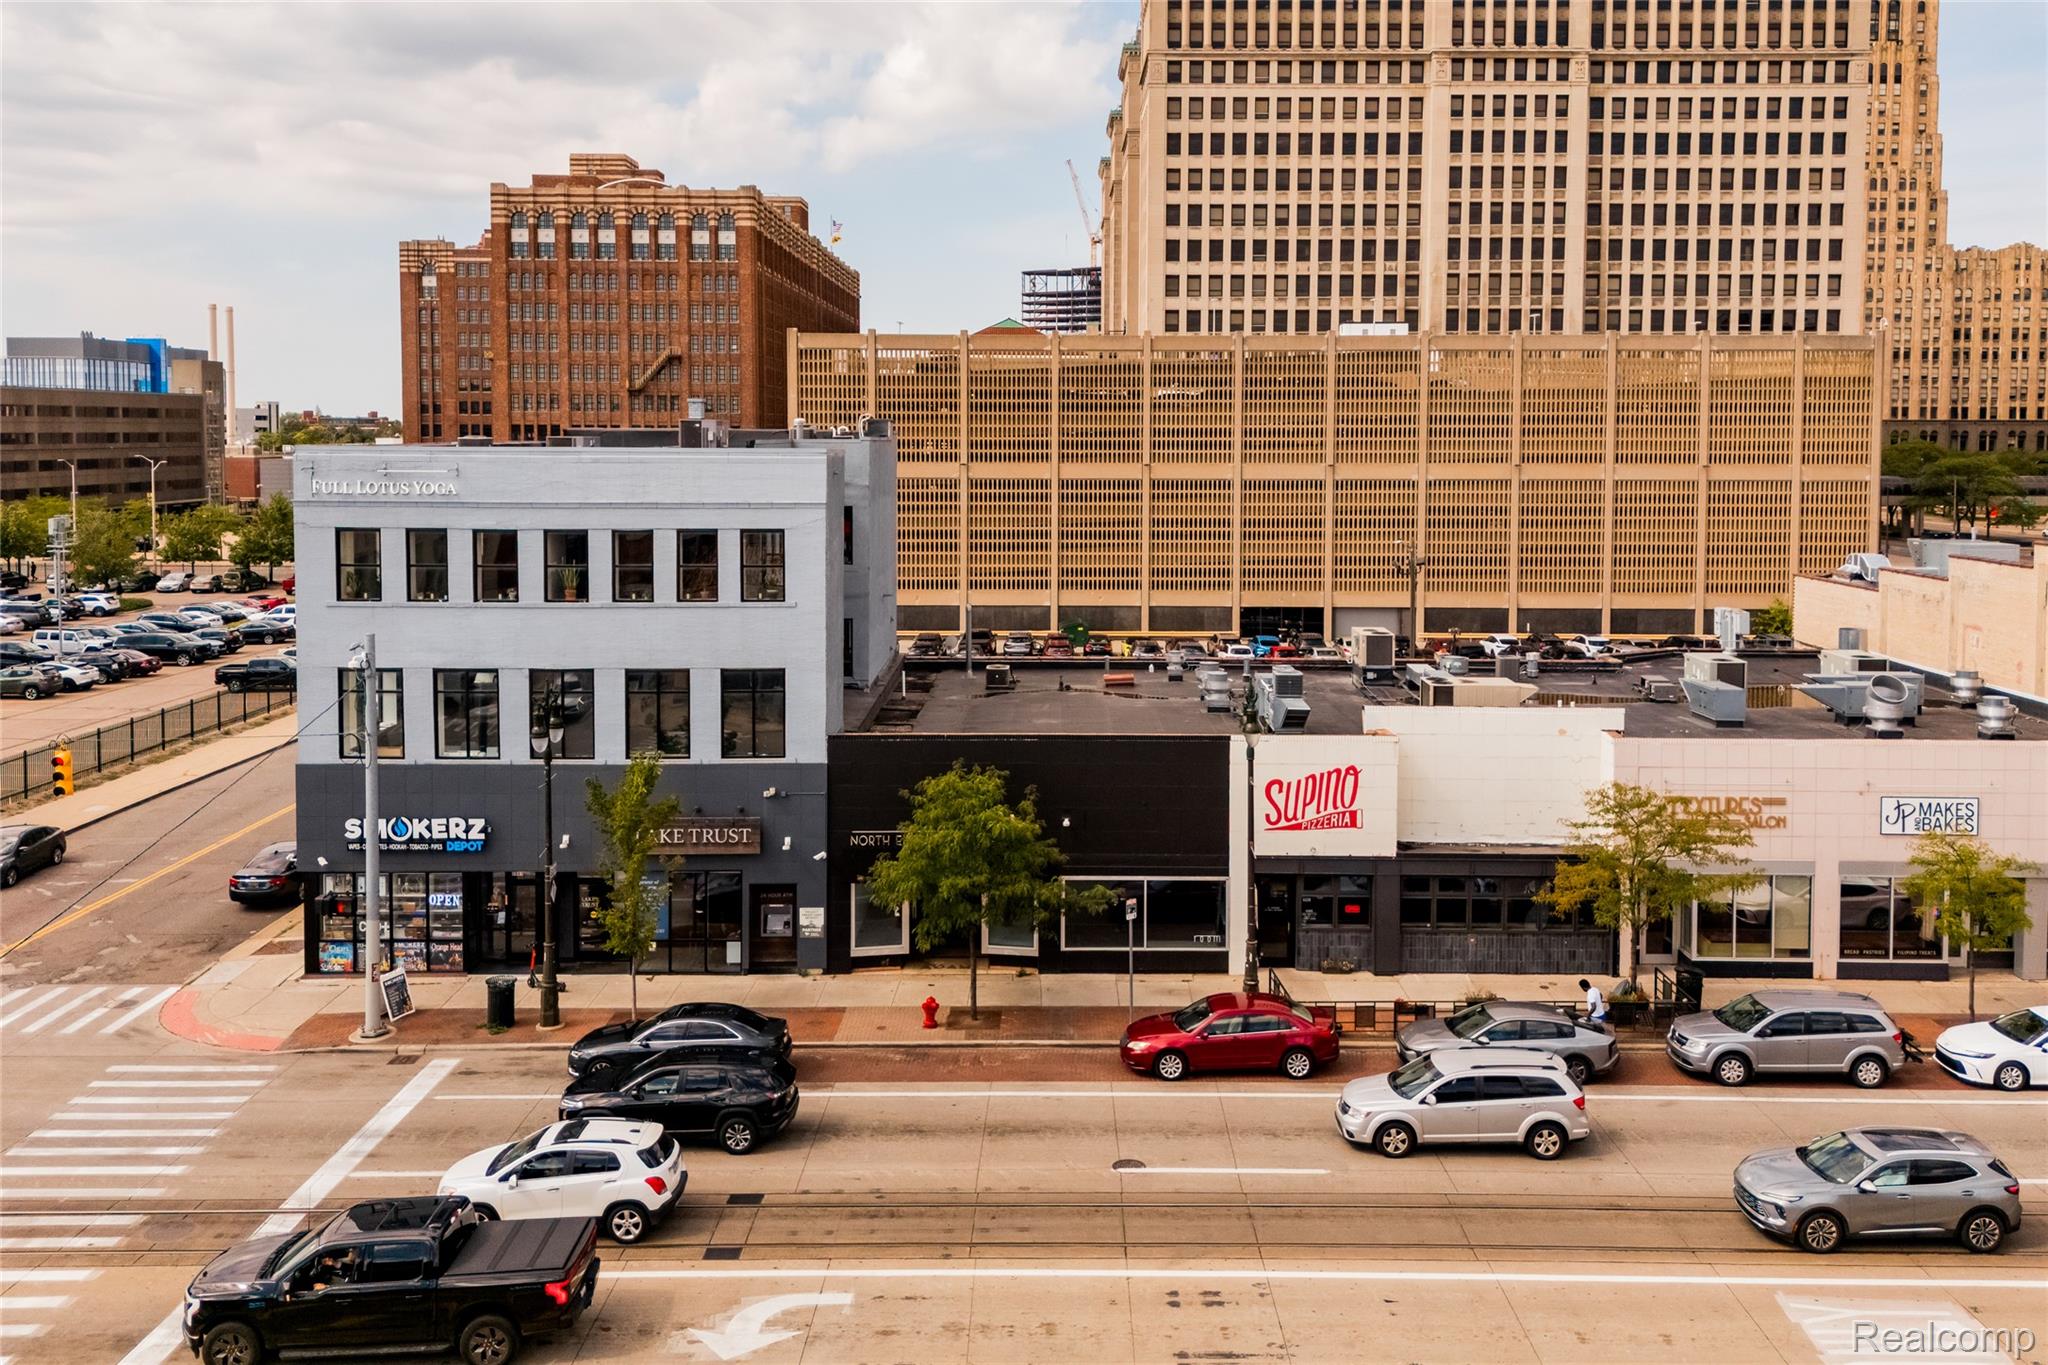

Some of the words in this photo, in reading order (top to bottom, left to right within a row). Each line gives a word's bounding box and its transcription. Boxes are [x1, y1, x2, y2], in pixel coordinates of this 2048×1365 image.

[312, 480, 353, 494] FULL
[357, 480, 409, 495] LOTUS
[413, 481, 457, 496] YOGA
[1264, 764, 1363, 826] SUPINO
[1885, 799, 1916, 832] JP
[1919, 802, 1975, 817] MAKES
[1301, 811, 1351, 830] PIZZERIA
[1743, 815, 1786, 829] SALON
[1922, 817, 1974, 832] BAKES
[688, 828, 752, 844] TRUST
[849, 834, 890, 847] NORTH
[446, 841, 484, 851] DEPOT
[428, 894, 460, 906] OPEN
[1194, 935, 1221, 943] room
